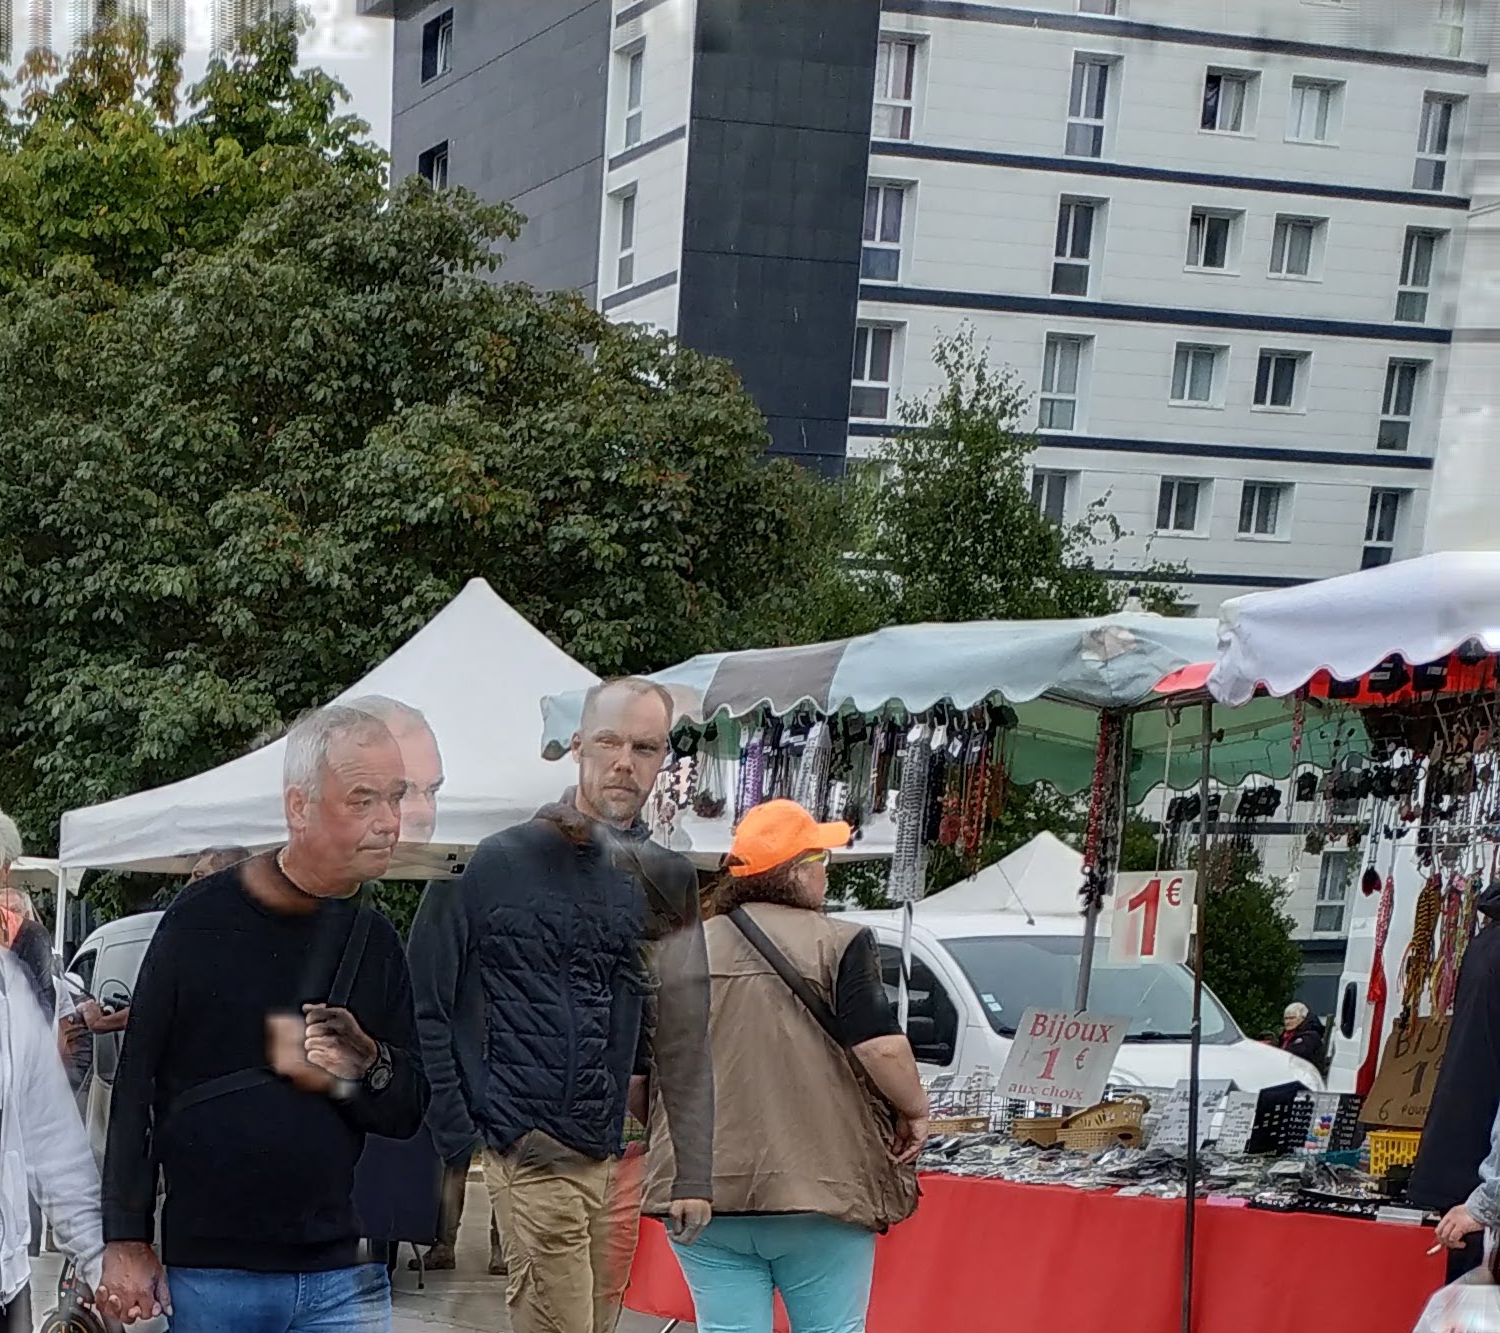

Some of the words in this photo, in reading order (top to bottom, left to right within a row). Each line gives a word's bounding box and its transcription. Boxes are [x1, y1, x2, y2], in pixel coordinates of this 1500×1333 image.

[1028, 1012, 1114, 1045] Bijoux
[1008, 1082, 1038, 1095] aux
[1041, 1085, 1085, 1101] choix
